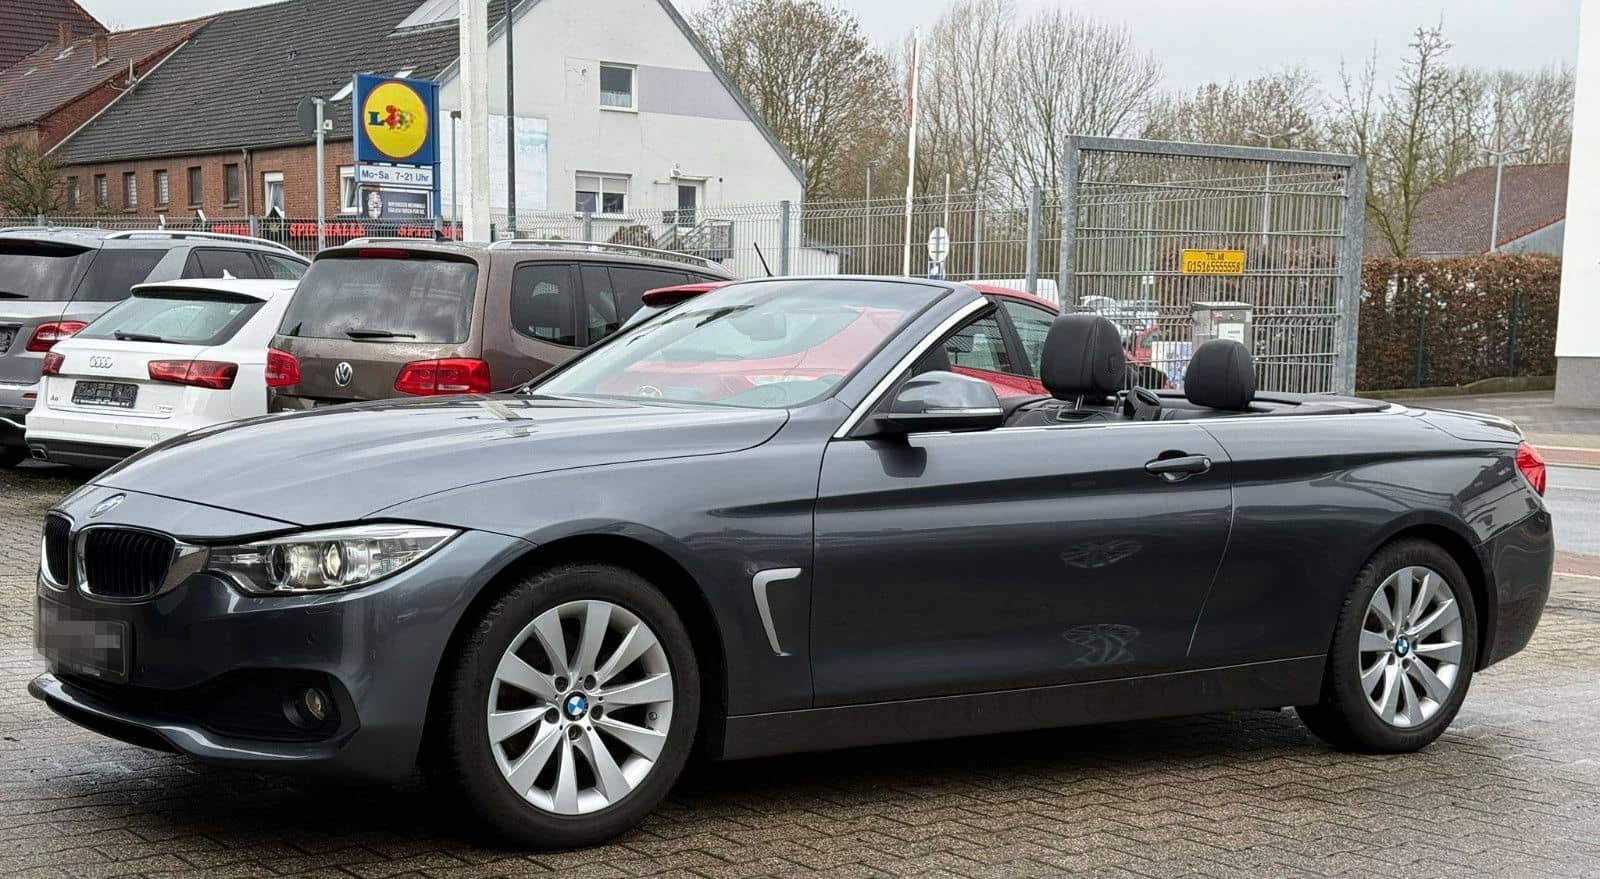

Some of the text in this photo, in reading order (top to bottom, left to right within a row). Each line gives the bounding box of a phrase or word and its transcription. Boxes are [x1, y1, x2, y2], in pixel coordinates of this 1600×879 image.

[361, 169, 429, 182] Mo-Sa 7-21 Uhr
